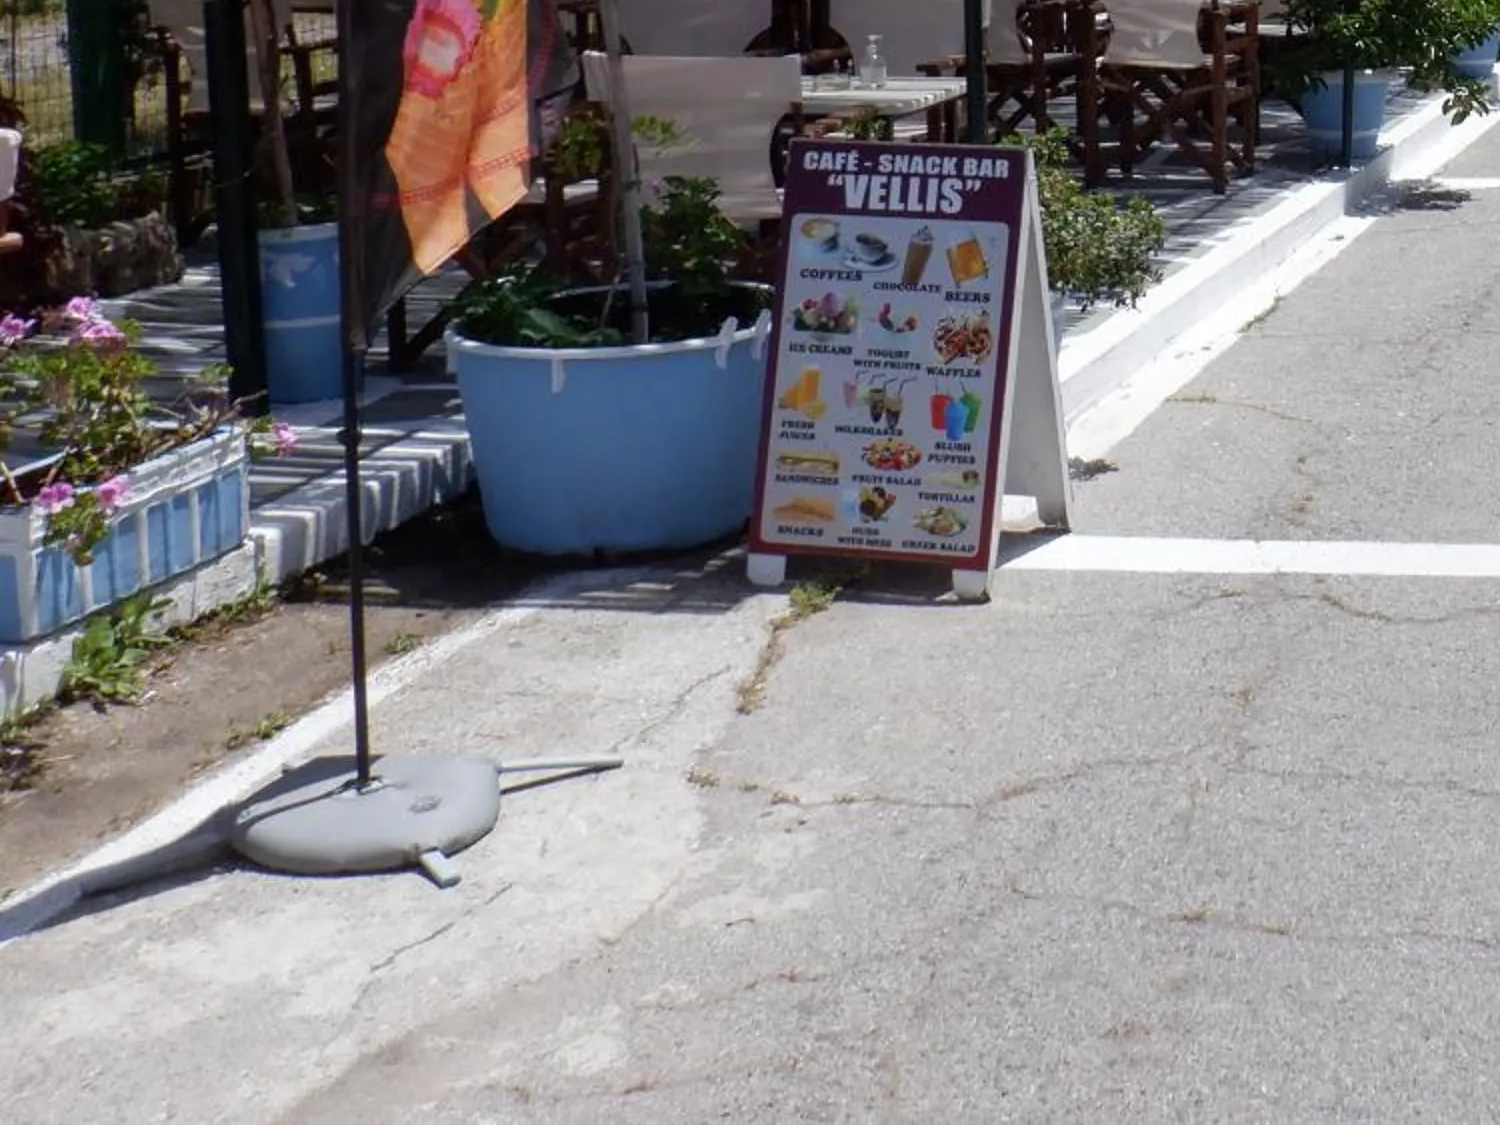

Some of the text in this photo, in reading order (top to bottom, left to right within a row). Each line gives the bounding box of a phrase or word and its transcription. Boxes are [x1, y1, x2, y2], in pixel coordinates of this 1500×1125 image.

[803, 150, 860, 172] CAFÉ
[877, 154, 959, 176] SNACK
[963, 158, 1010, 179] BAR
[800, 268, 864, 282] COFFEES
[873, 280, 943, 294] CHOCOLATE
[944, 289, 992, 304] BEERS
[788, 342, 853, 355] ICE CREAMS
[853, 358, 921, 372] WITH FRUITS
[925, 366, 982, 379] WAFFLES
